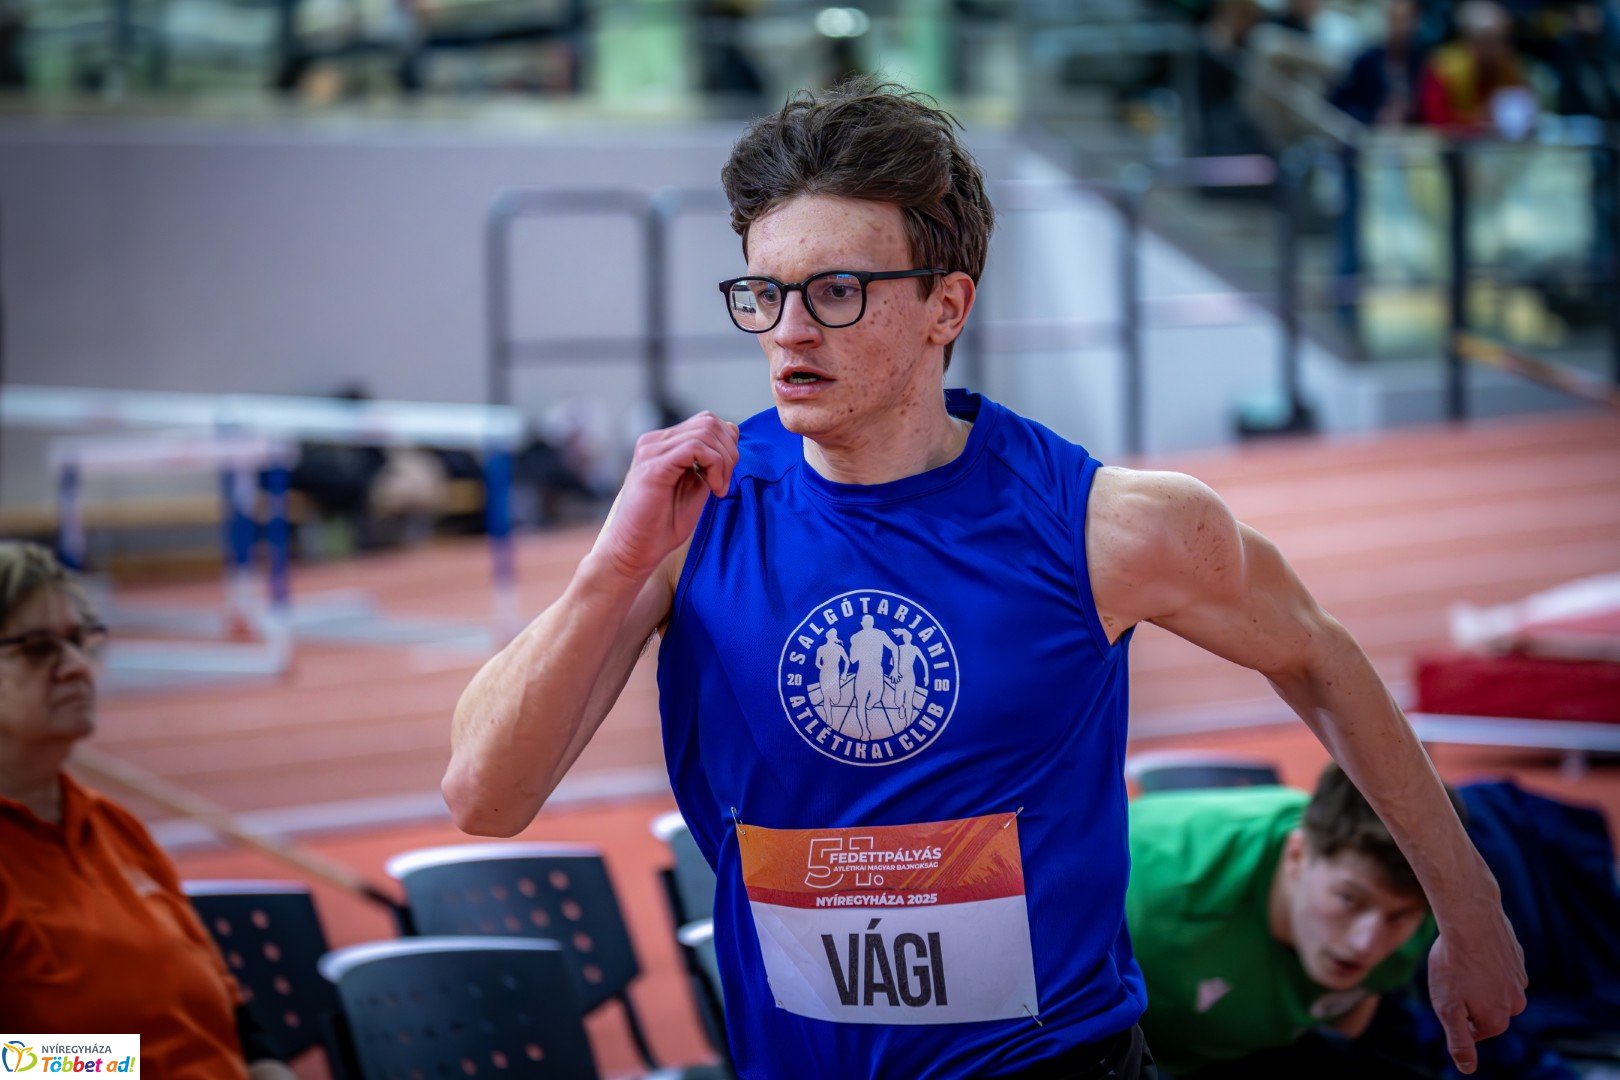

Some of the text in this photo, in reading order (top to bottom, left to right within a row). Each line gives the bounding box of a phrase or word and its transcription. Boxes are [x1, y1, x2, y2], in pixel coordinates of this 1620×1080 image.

[789, 597, 950, 669] SALGÓTARJÁNI
[787, 673, 802, 686] 20
[934, 679, 950, 692] 00
[789, 695, 945, 760] ATLÉTIKAI CLUB
[830, 846, 942, 864] FEDETTPÁLYÁS
[833, 861, 939, 873] ATLÉTIKAI MAGYAR BAJNOKSÁG
[815, 893, 938, 907] NYÍREGYHÁZA 2025
[821, 918, 948, 1007] VÁGI
